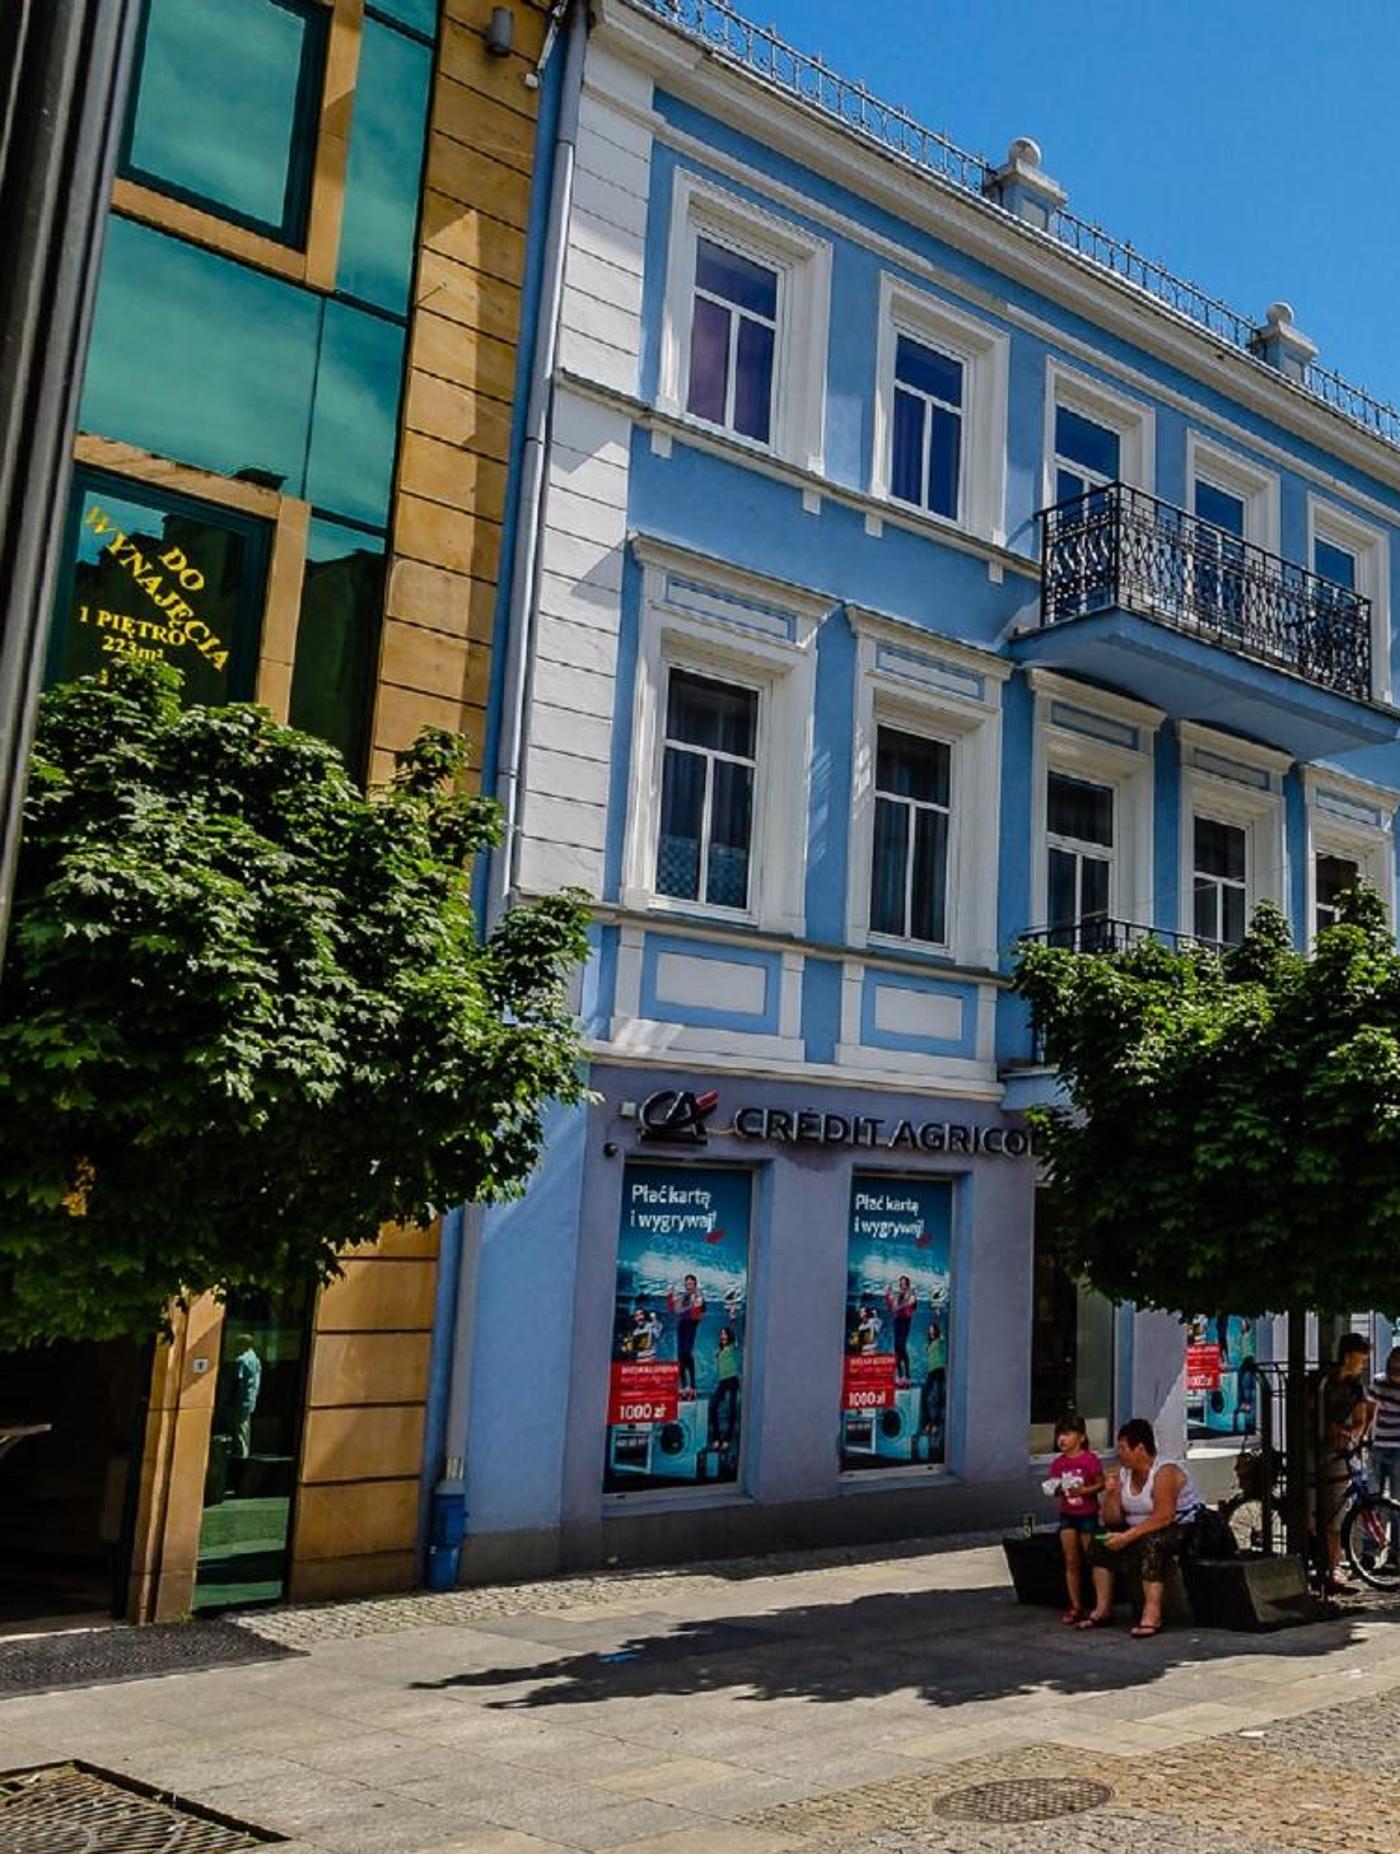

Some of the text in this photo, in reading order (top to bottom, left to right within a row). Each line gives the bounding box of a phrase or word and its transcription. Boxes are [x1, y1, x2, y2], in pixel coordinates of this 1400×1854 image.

[84, 506, 229, 671] WYNAJĘCIA
[158, 546, 205, 591] DO
[79, 606, 186, 646] 1 PIĘTRO
[733, 1106, 886, 1149] CRÉDIT
[888, 1119, 1050, 1158] AGRICOL
[668, 1185, 711, 1209] kartą
[619, 1403, 652, 1420] 1000
